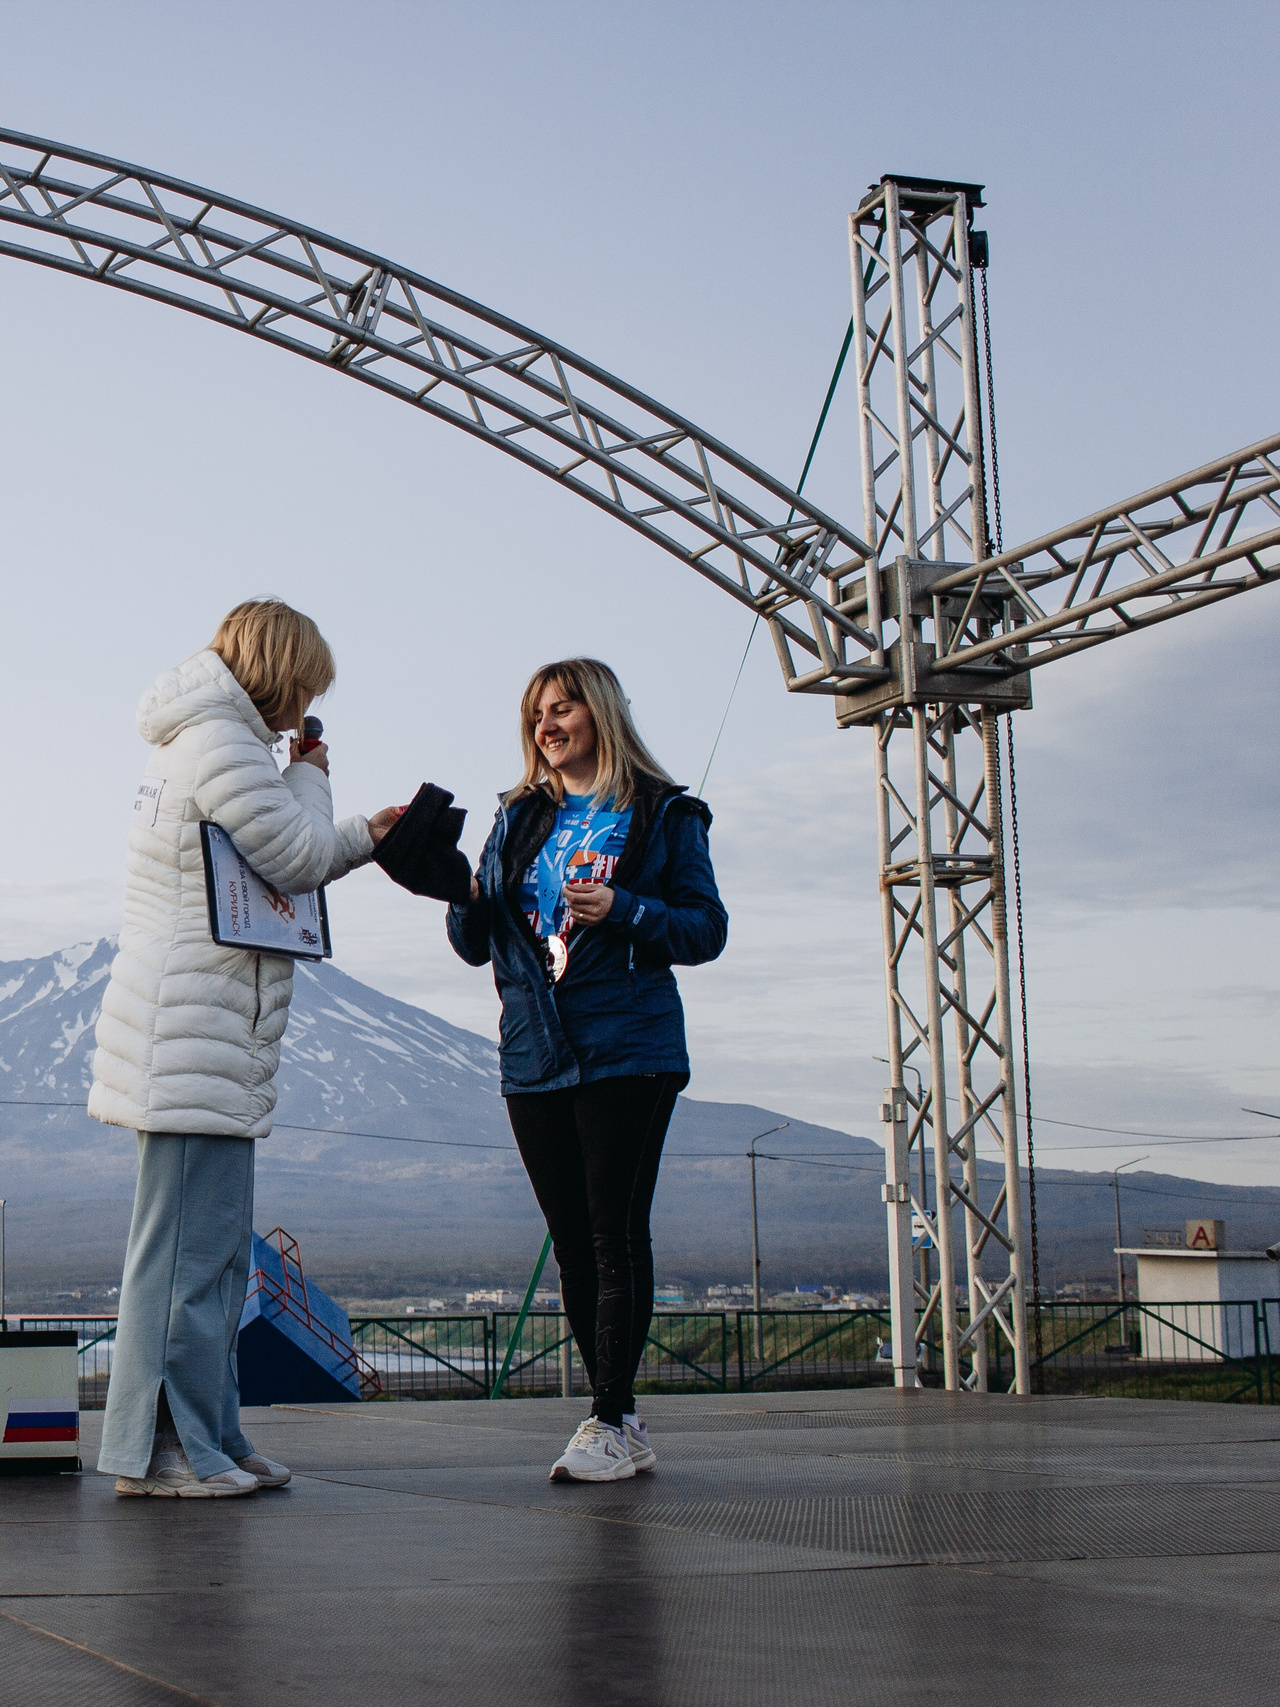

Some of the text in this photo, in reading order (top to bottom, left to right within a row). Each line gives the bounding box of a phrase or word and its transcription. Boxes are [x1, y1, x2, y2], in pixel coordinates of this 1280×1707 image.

[239, 869, 247, 880] ЗА
[240, 881, 250, 902] СВОЙ
[228, 880, 241, 937] КУРИЛЬСК
[242, 903, 251, 929] ГОРОД
